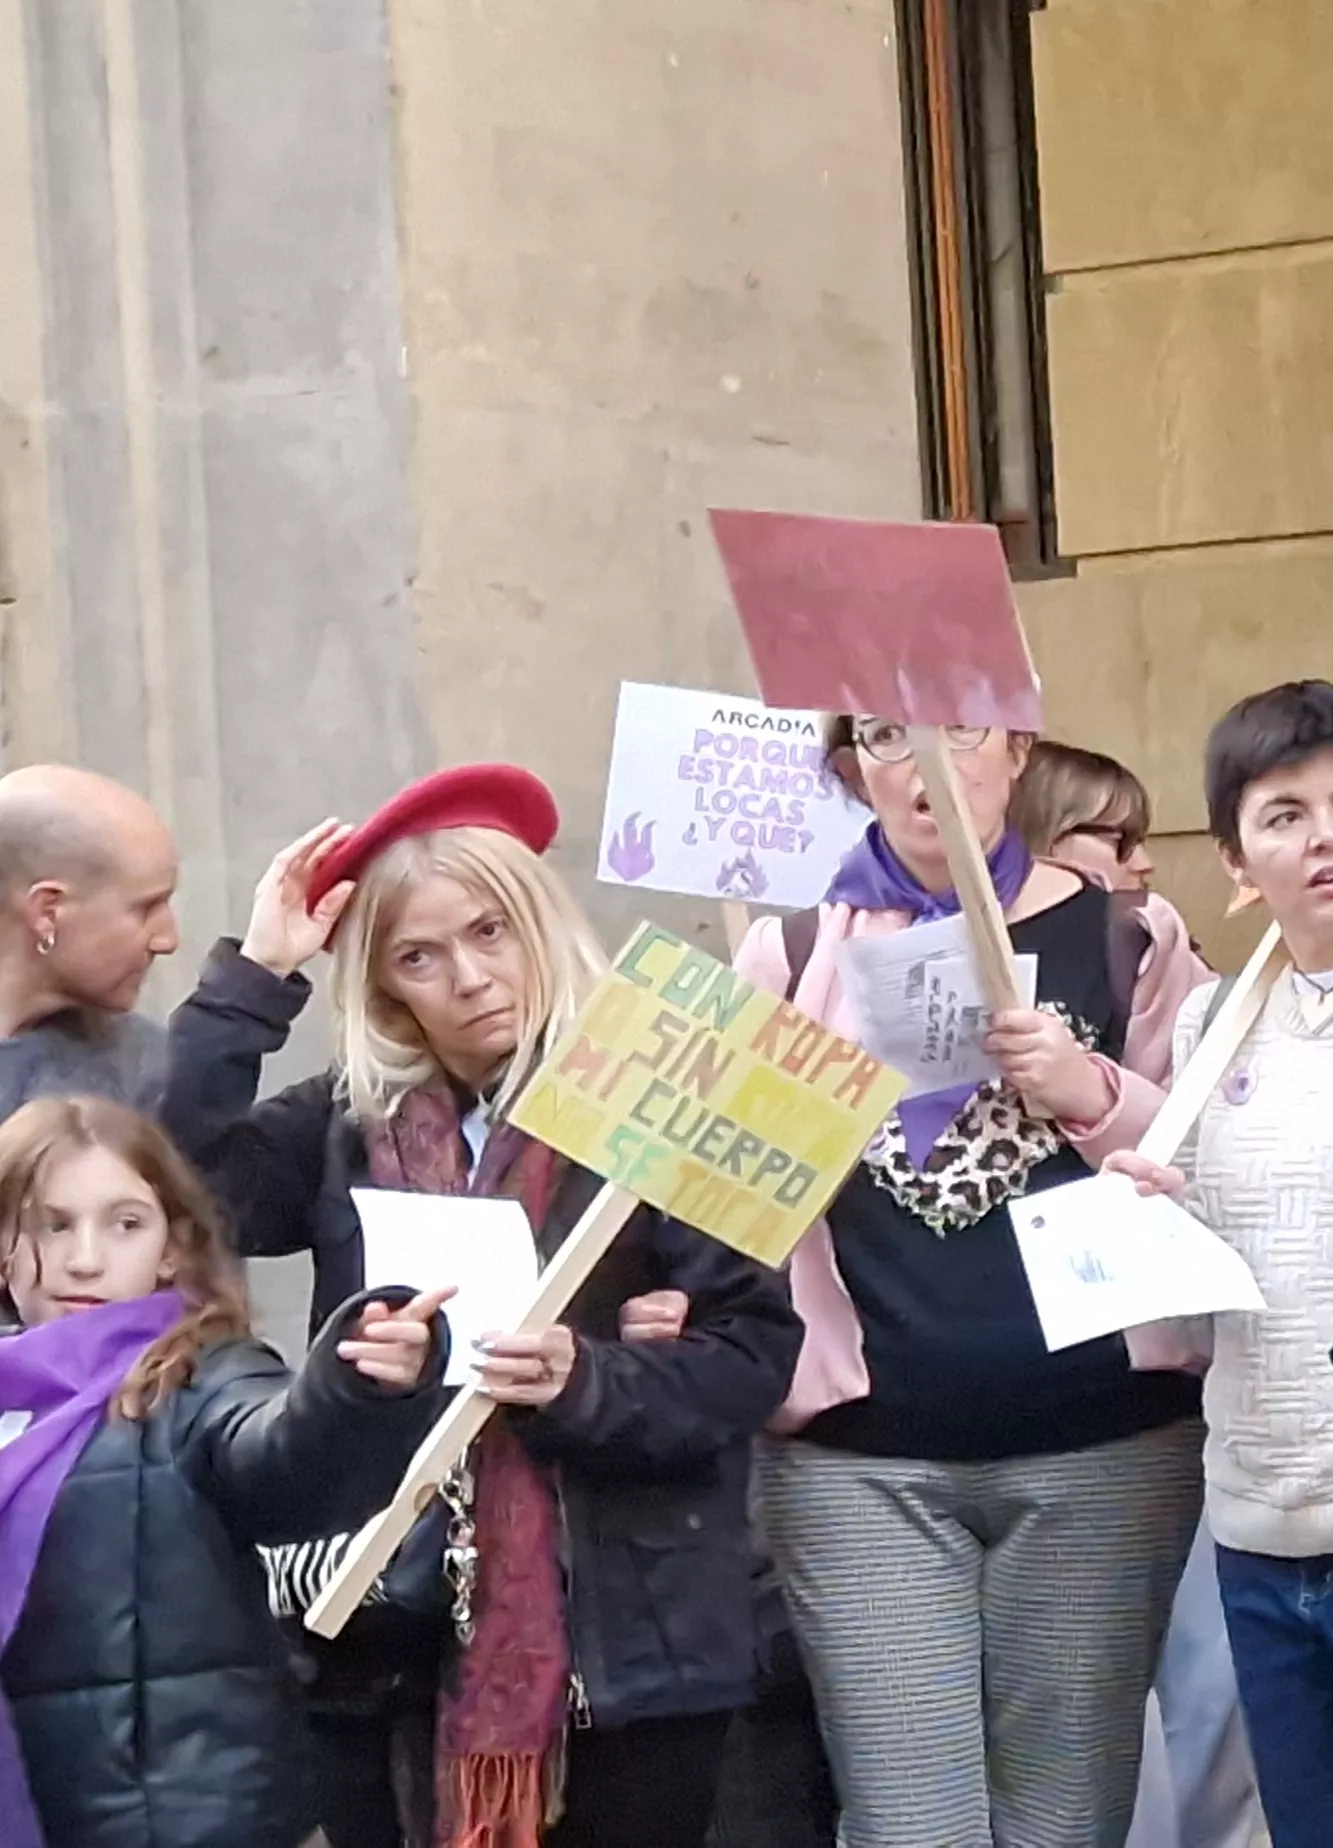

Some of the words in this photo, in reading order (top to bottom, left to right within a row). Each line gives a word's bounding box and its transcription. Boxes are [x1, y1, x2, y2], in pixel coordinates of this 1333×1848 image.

[694, 787, 806, 826] LOCAS
[616, 926, 755, 1033] CON
[749, 1000, 883, 1110] ROPA
[554, 1033, 629, 1101] MI
[627, 1078, 820, 1210] CUERPO
